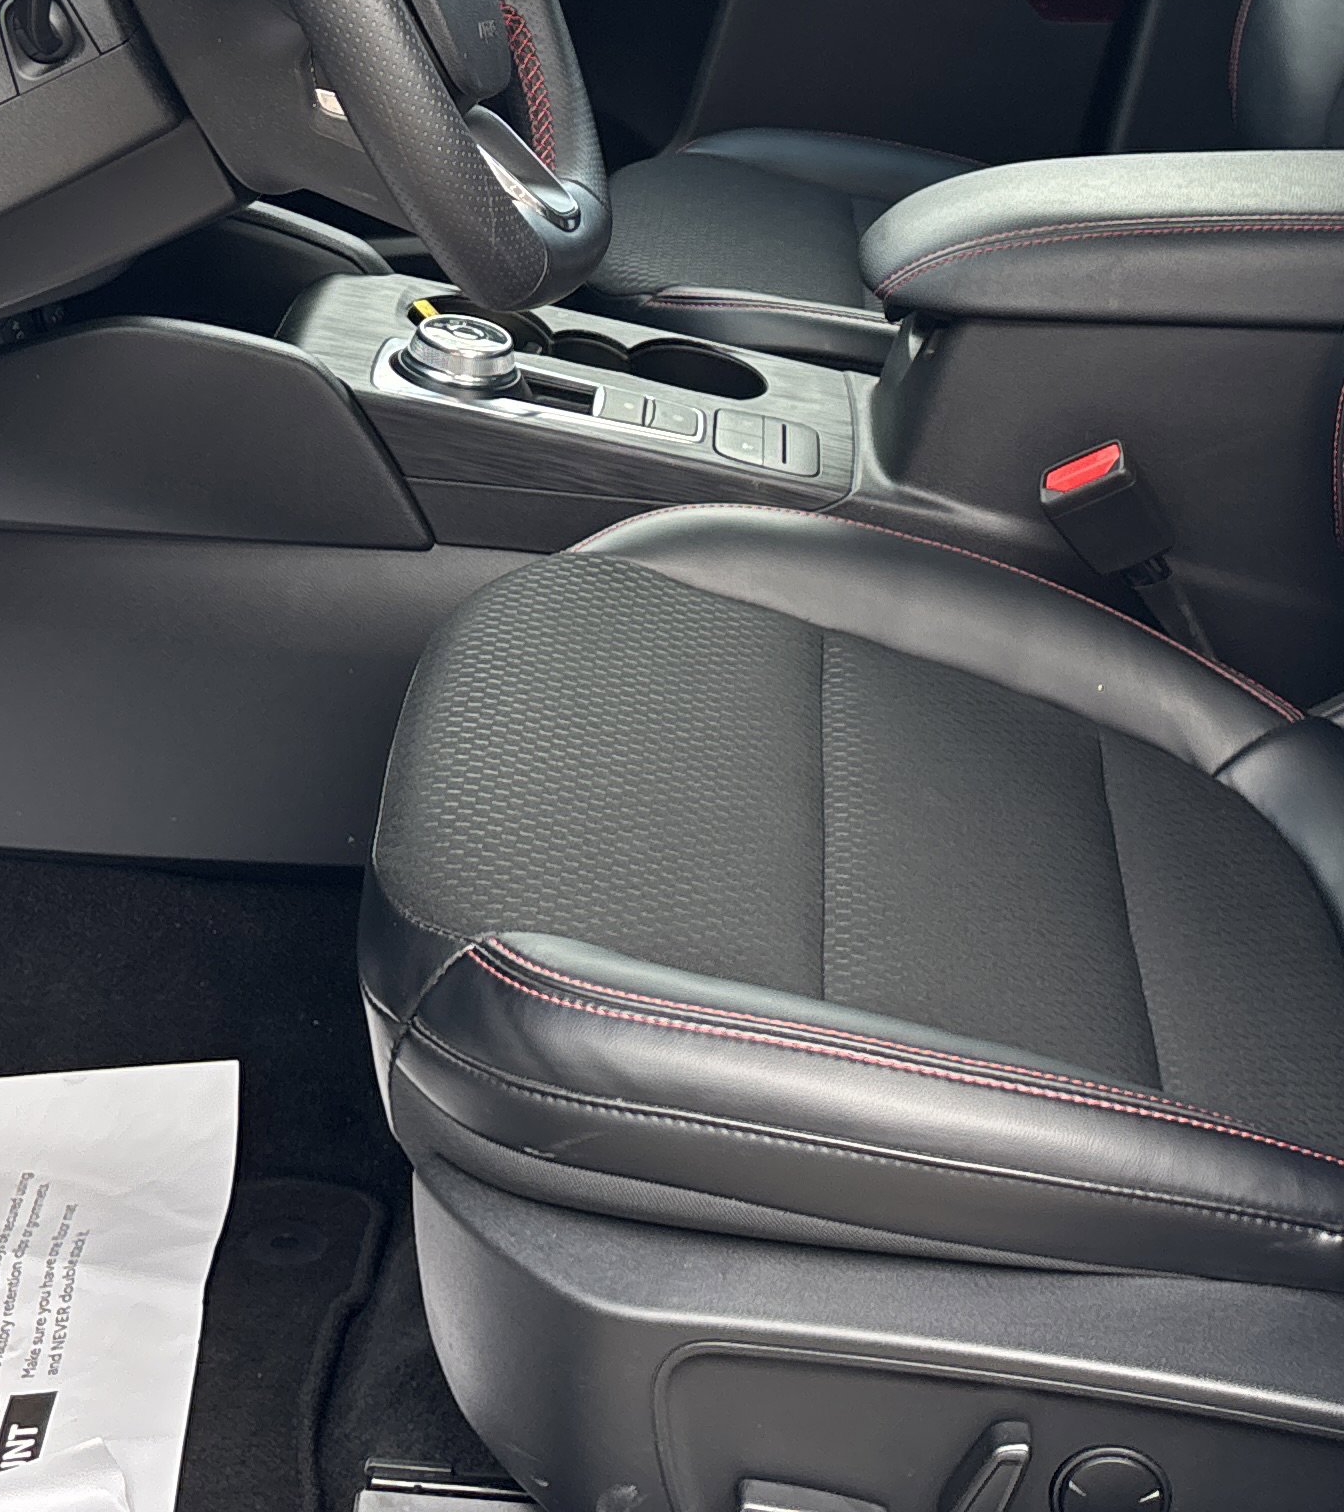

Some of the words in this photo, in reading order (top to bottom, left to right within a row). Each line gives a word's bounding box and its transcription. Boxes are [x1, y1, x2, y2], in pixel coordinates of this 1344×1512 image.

[3, 1261, 23, 1317] retention
[38, 1258, 57, 1289] have
[38, 1290, 52, 1315] you
[32, 1317, 47, 1345] sure
[50, 1306, 71, 1351] NEVER
[20, 1348, 42, 1379] Make
[47, 1353, 63, 1376] and
